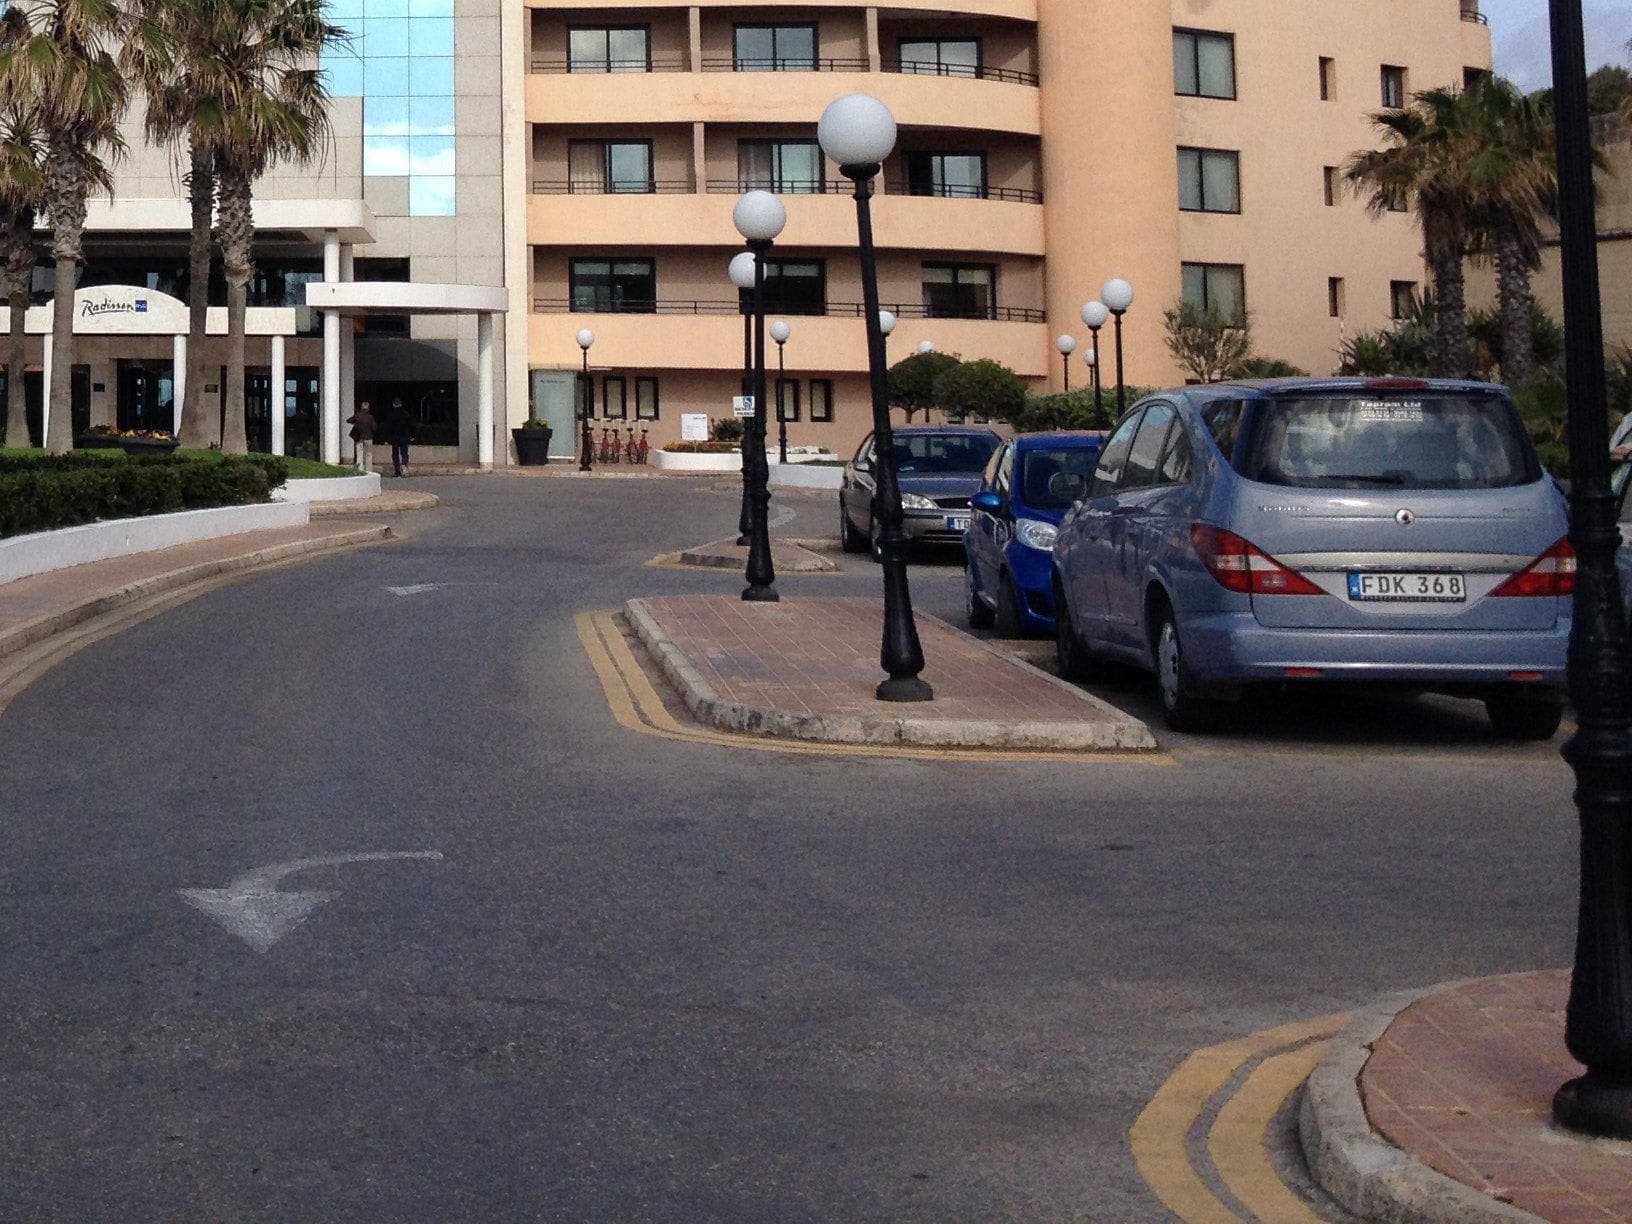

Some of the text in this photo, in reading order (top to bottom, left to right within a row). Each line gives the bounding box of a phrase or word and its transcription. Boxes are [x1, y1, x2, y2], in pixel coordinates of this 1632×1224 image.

[82, 297, 134, 317] Radisson
[1361, 576, 1461, 595] FDK 368
